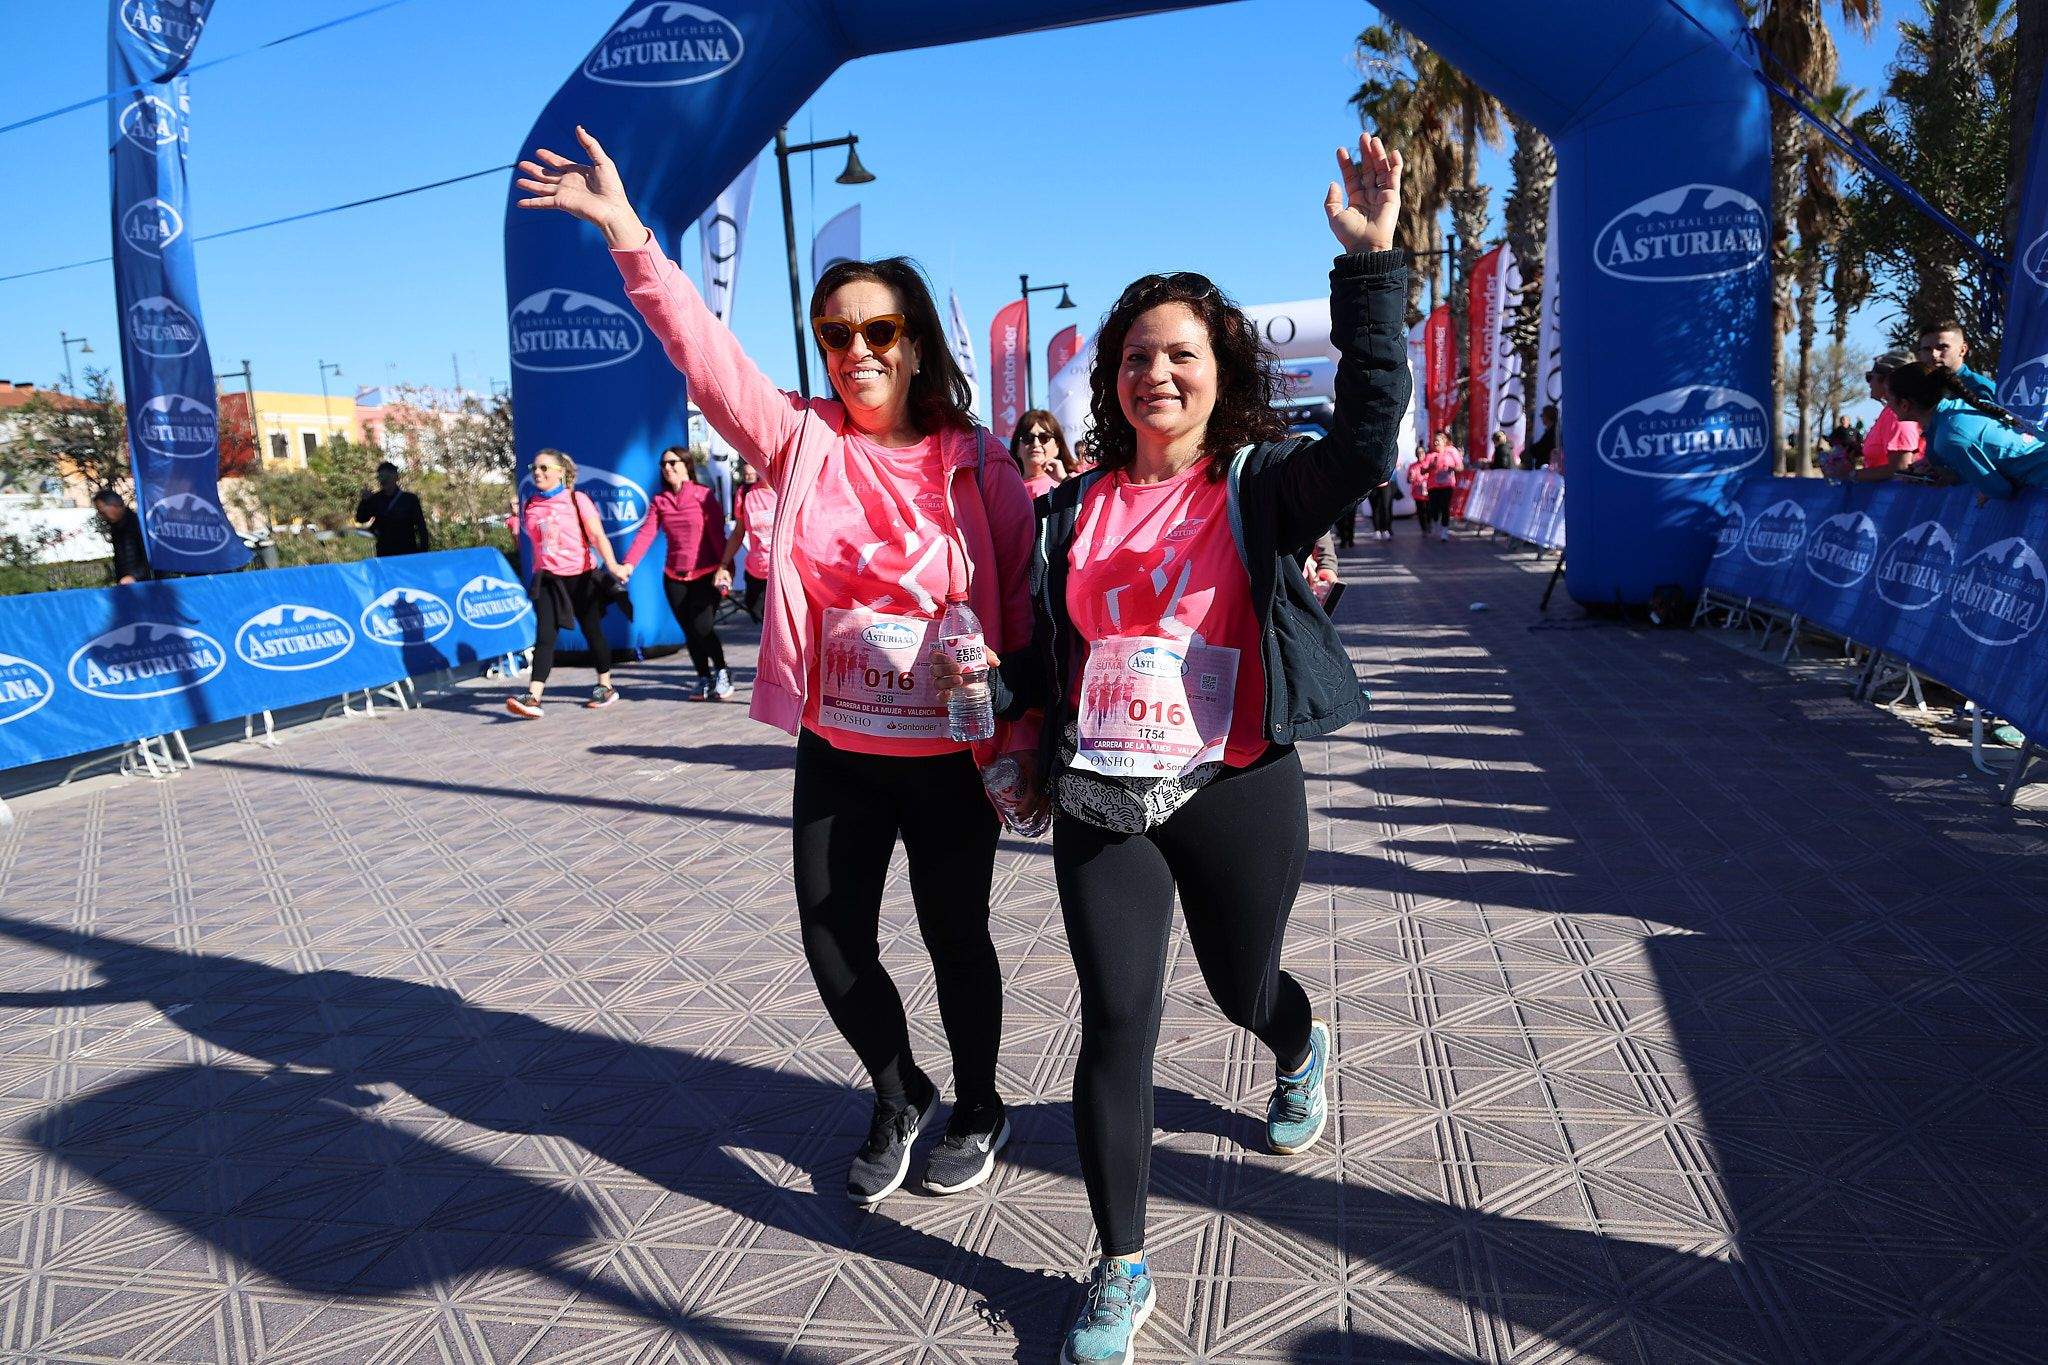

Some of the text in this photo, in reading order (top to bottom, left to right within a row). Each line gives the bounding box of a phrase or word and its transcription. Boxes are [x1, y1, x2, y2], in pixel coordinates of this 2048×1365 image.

[591, 38, 732, 74] ASTURIANA
[1636, 217, 1702, 233] CENTRAL
[1606, 227, 1763, 266] ASTURIANA
[1481, 273, 1498, 367] Santander
[511, 323, 632, 354] ASTURIANA
[1003, 325, 1018, 403] Santander
[1638, 416, 1705, 432] CENTRAL
[1610, 424, 1763, 459] ASTURIANA
[249, 628, 348, 661] ASTURIANA
[956, 654, 982, 663] SODIO
[1095, 661, 1123, 672] SUMA
[86, 648, 219, 689] ASTURIANA
[864, 668, 914, 691] 016
[875, 694, 894, 704] 389
[835, 700, 861, 710] CARRERA
[880, 707, 902, 715] MUJER
[1128, 699, 1186, 726] 016
[833, 712, 872, 727] OYSHO
[897, 722, 937, 731] Santander
[1138, 728, 1165, 740] 1754
[1093, 740, 1123, 749] CARRERA
[1136, 743, 1146, 751] LA
[1090, 755, 1135, 768] OYSHO
